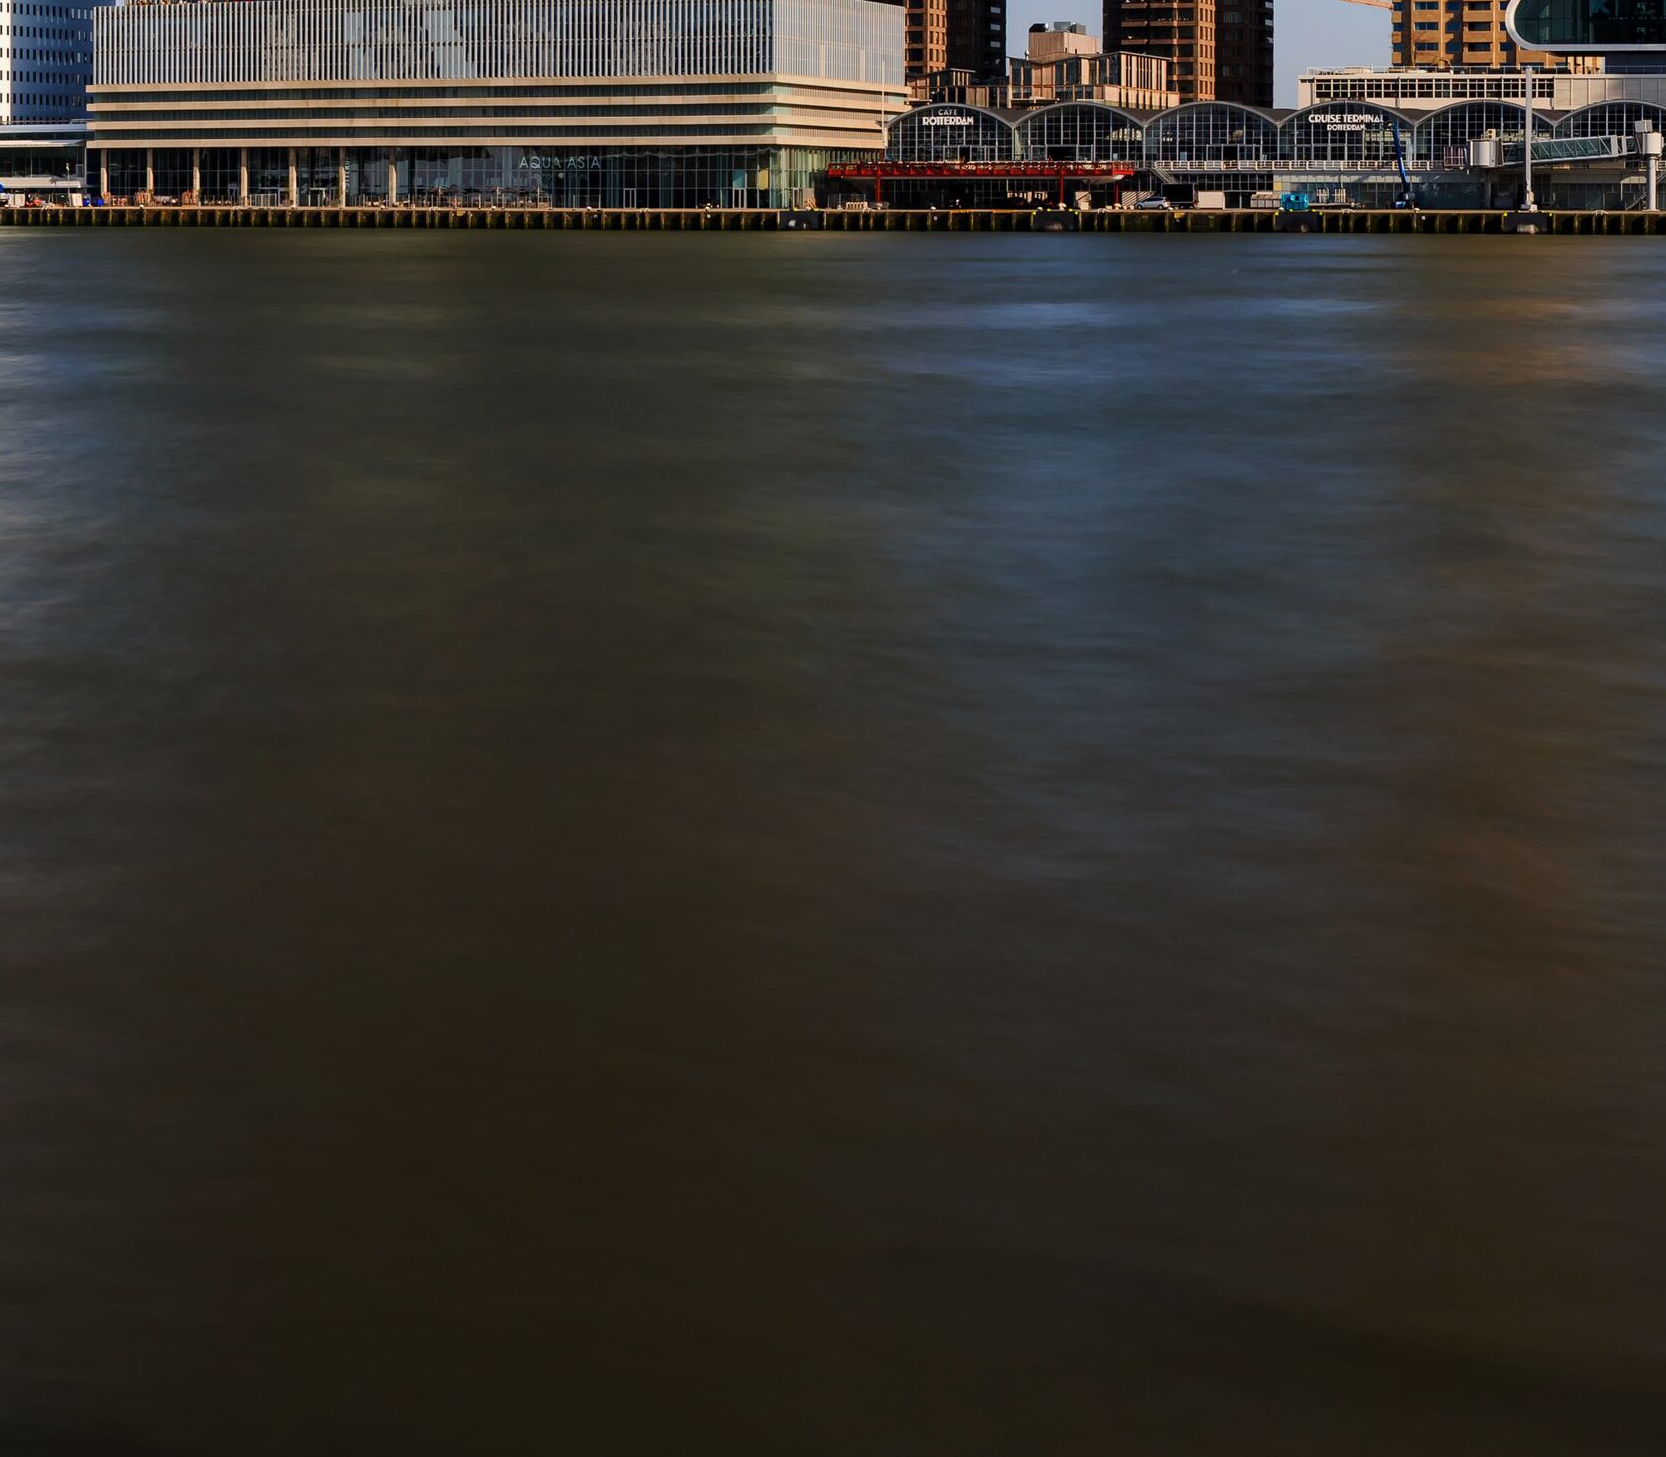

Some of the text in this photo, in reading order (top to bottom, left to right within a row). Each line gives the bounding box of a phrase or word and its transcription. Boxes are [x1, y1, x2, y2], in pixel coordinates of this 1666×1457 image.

[922, 116, 974, 126] ROTTERDAM
[1308, 114, 1384, 123] CRUISE TERMINAL
[1326, 124, 1366, 132] ROTTERDAM
[518, 156, 601, 169] AQUA ASIA
